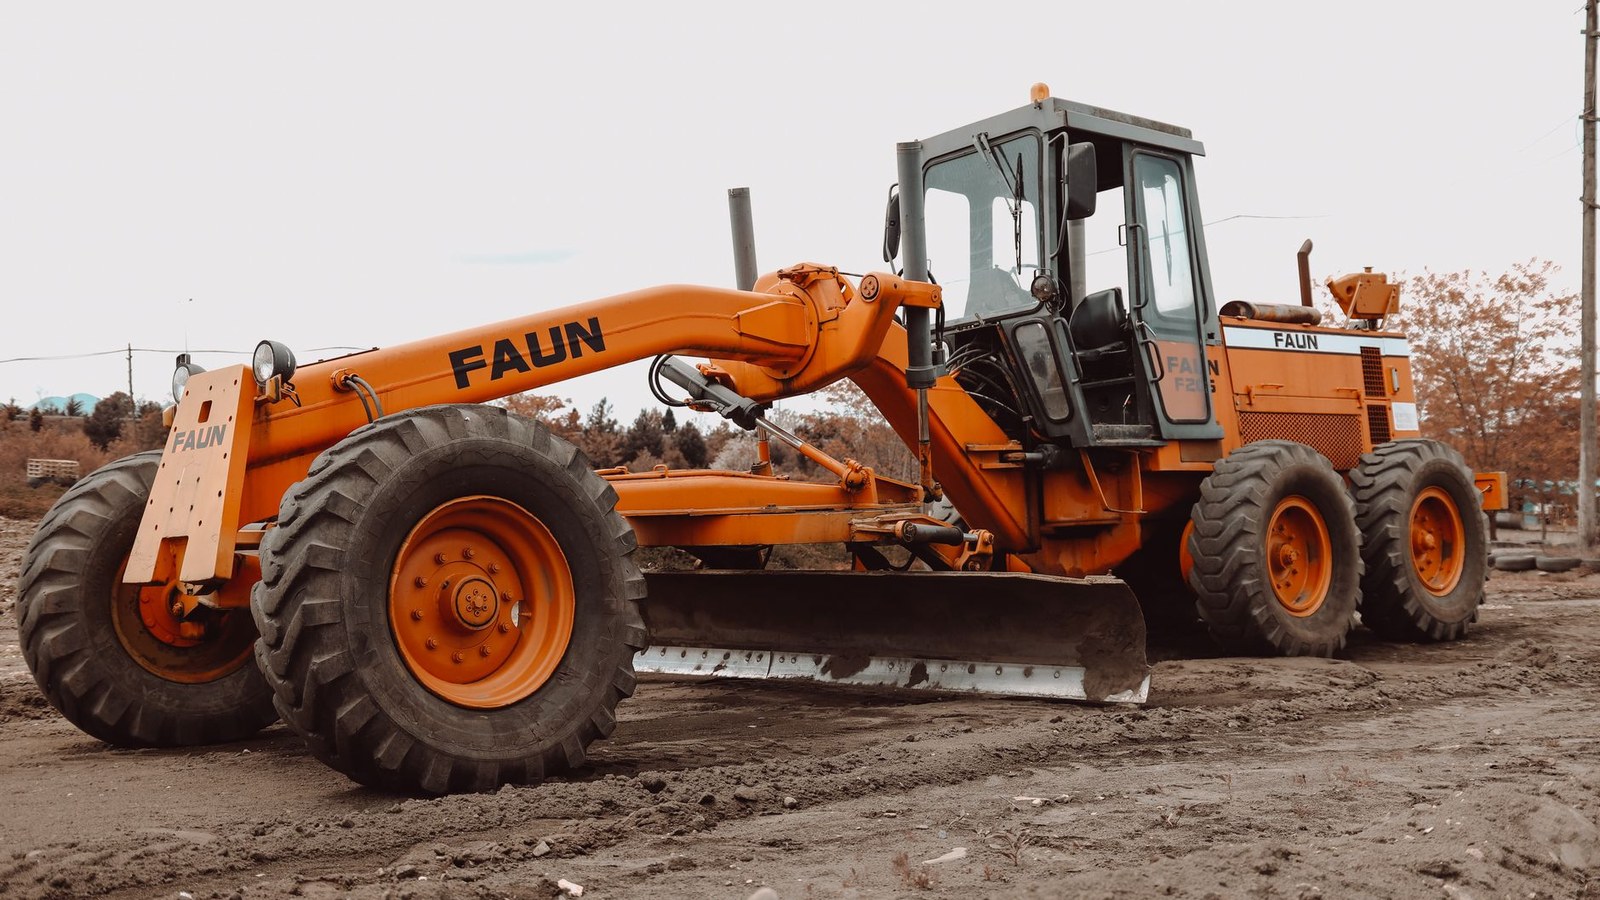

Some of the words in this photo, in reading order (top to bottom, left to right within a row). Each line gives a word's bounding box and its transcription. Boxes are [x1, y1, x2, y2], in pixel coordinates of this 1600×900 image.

[448, 316, 607, 390] FAUN
[1273, 332, 1319, 350] FAUN
[171, 424, 227, 454] FAUN
